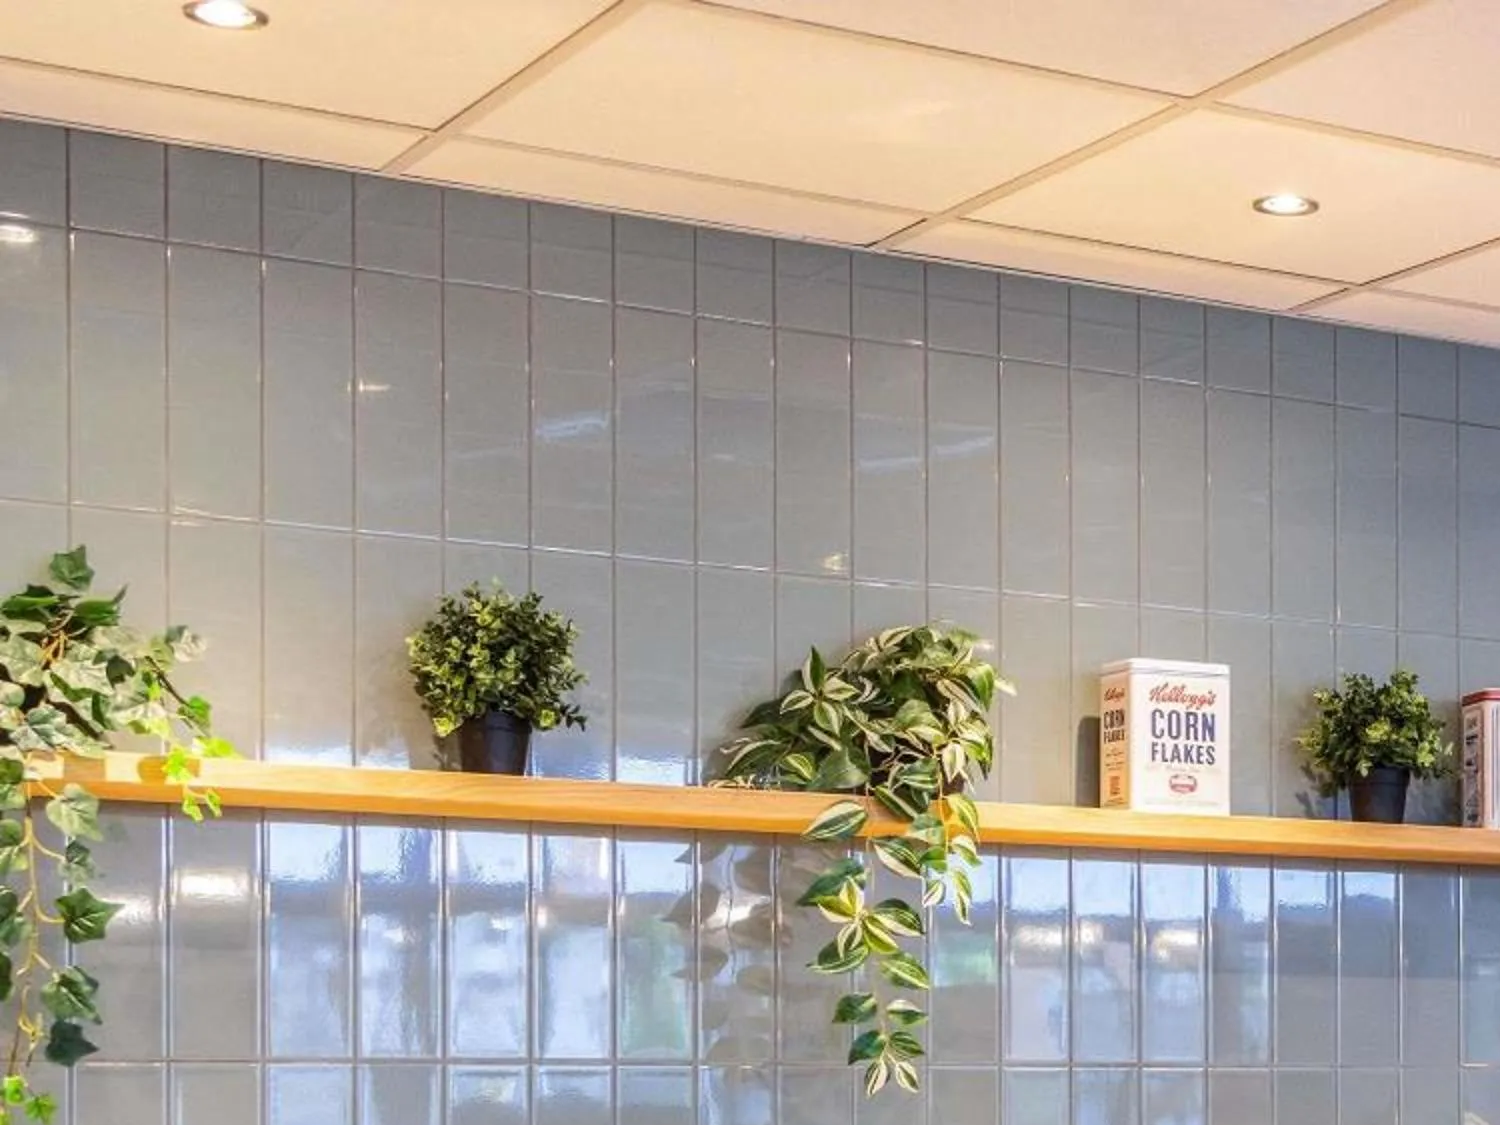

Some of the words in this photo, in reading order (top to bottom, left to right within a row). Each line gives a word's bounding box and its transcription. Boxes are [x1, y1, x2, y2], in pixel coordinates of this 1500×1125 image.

[1149, 682, 1216, 710] Kellogg's
[1151, 709, 1215, 742] CORN
[1151, 742, 1216, 765] FLAKES
